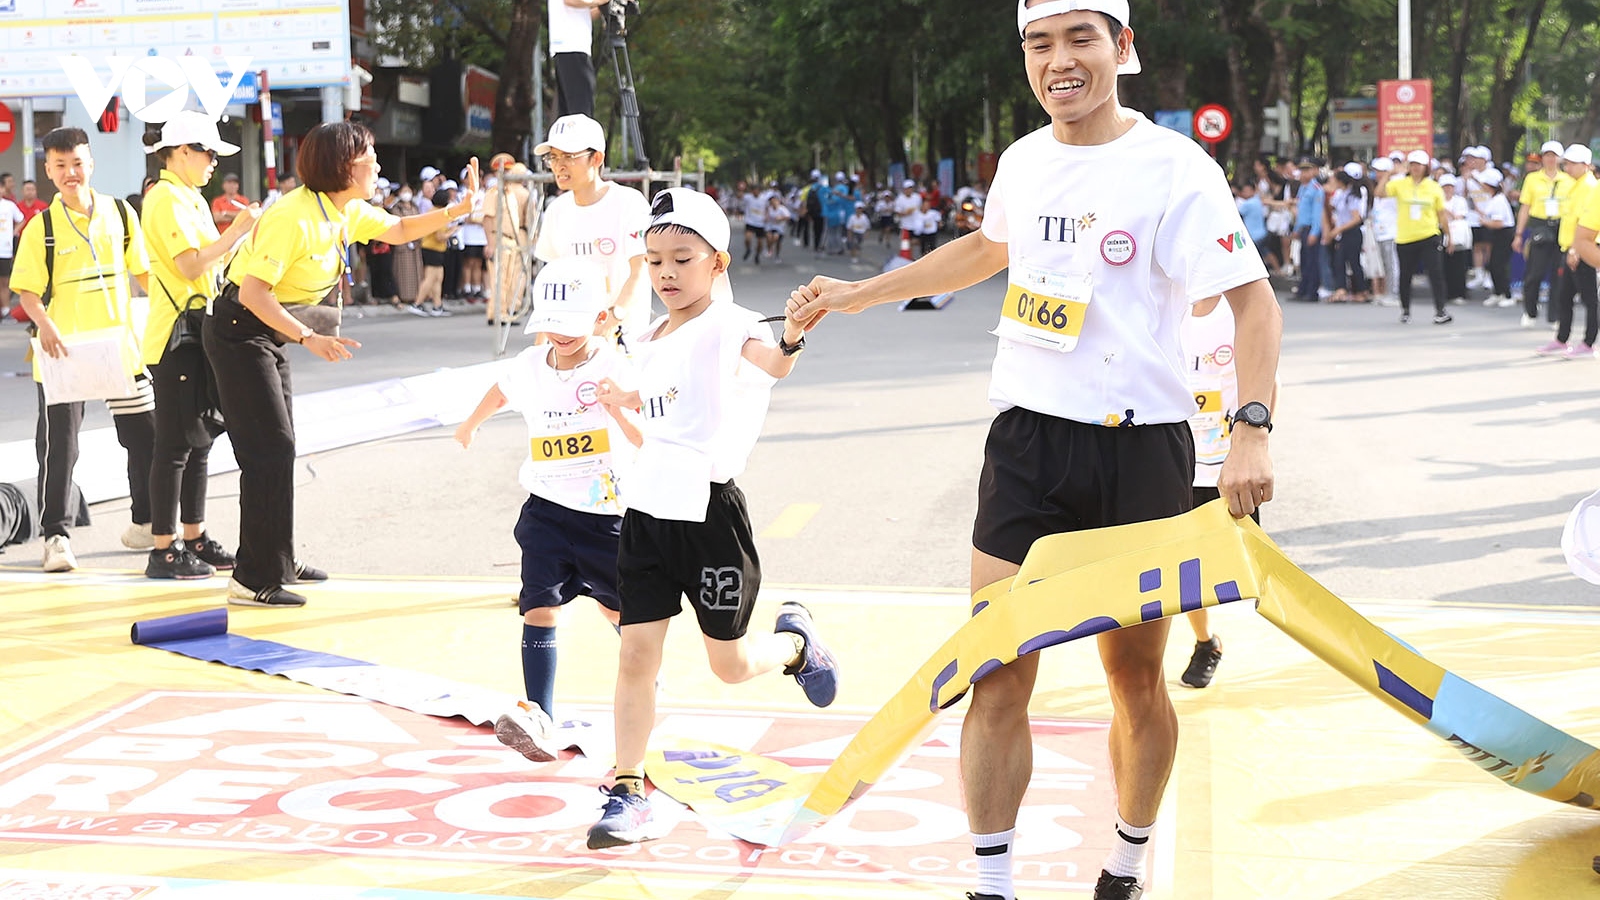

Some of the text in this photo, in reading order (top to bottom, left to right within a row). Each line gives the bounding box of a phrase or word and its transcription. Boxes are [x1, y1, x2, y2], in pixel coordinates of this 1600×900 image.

[1038, 215, 1077, 244] TH
[542, 282, 567, 301] TH
[1017, 292, 1068, 330] 0166
[542, 434, 594, 458] 0182
[701, 566, 744, 611] 32
